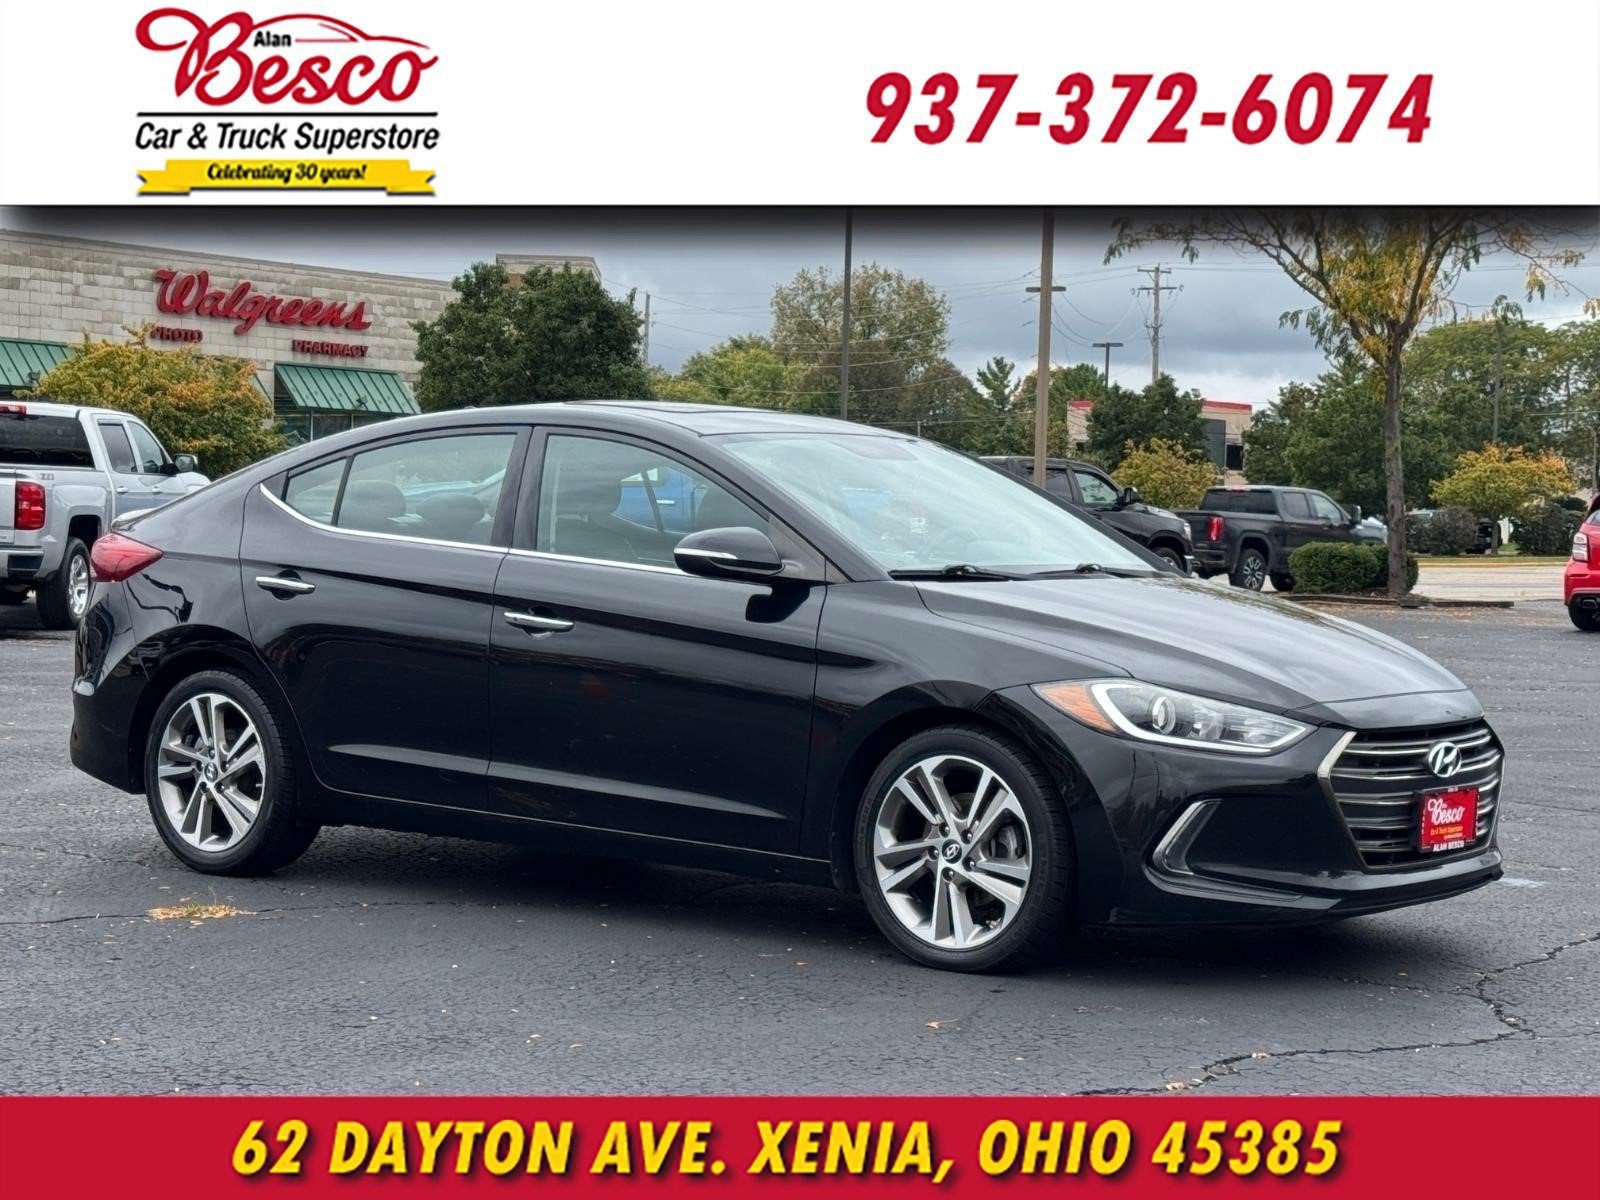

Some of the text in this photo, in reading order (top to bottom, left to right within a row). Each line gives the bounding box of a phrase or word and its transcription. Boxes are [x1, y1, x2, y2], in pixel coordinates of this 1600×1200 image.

[154, 269, 371, 335] Walgreens
[151, 326, 203, 342] PHOTO
[292, 339, 369, 358] PHARMACY
[1428, 798, 1465, 825] Besco
